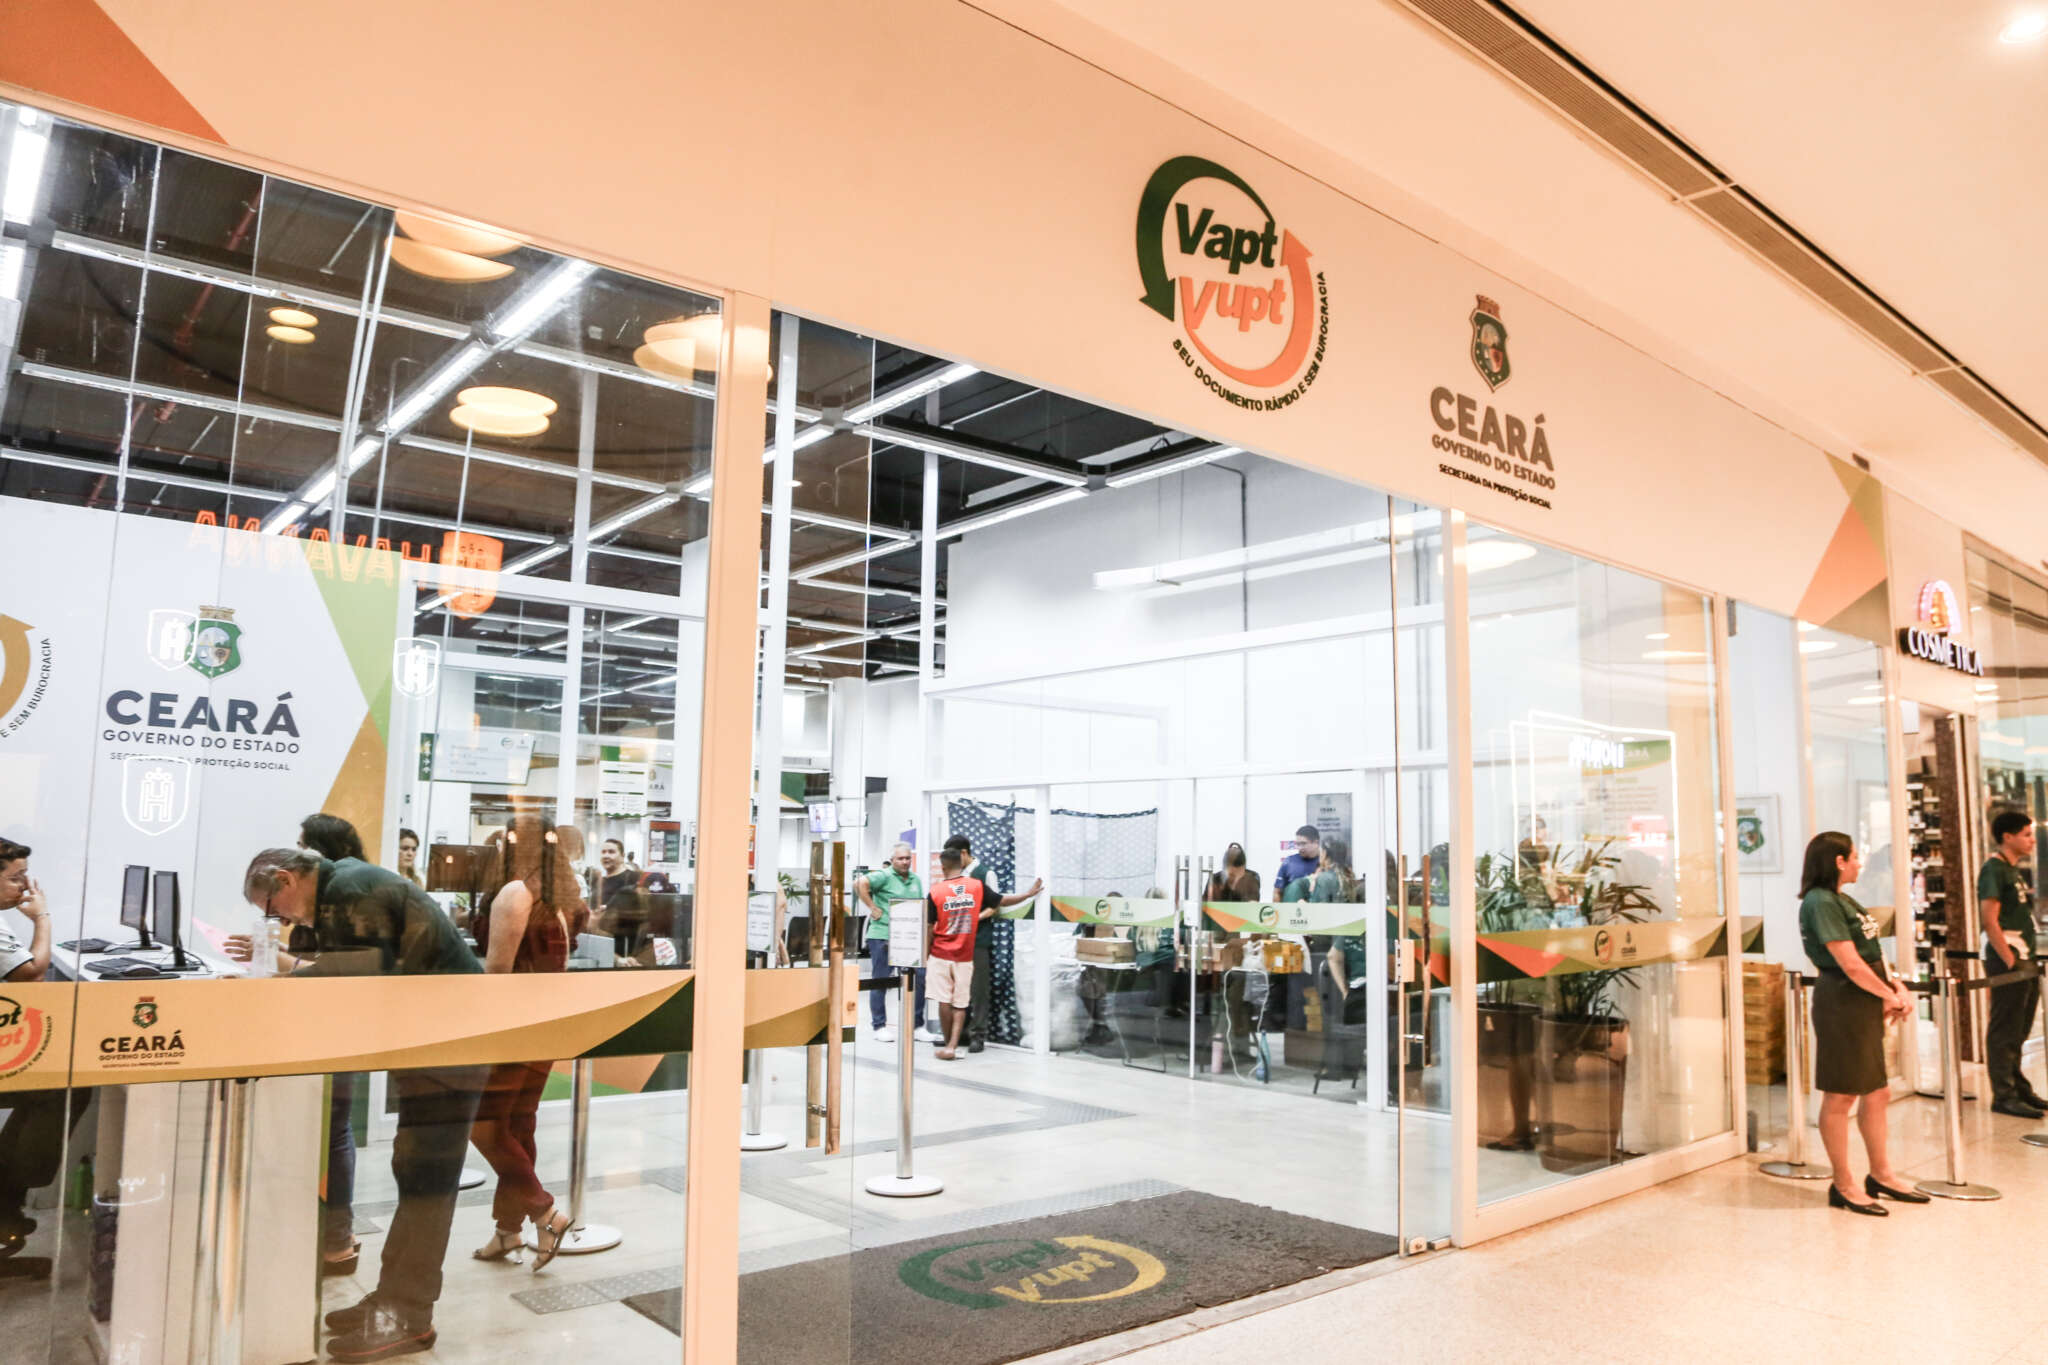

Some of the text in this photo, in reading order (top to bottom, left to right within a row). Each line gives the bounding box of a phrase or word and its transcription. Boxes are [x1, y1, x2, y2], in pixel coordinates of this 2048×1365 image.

[1175, 202, 1278, 275] Vapt
[1179, 276, 1287, 332] Vupt
[1173, 272, 1329, 411] SEU DOCUMENTO RÁPIDO E SEM BUROCRACIA
[1430, 386, 1554, 471] CEARÁ
[1432, 434, 1555, 490] GOVERNO DO ESTADO
[1439, 463, 1552, 510] SECRETARIA DA PROTEÇÃO SOCIAL
[1908, 626, 1984, 676] COSMETICA
[0, 638, 52, 738] E SEM BUROCRACIA
[106, 690, 300, 738] CEARÁ
[103, 729, 300, 754] GOVERNO DO ESTADO
[195, 757, 251, 769] PROTEÇÃO
[253, 761, 290, 771] SOCIAL
[99, 1053, 139, 1062] GOVERNO
[155, 1051, 185, 1059] ESTADO
[100, 1030, 185, 1053] CEARÁ
[991, 1251, 1116, 1301] Vupt
